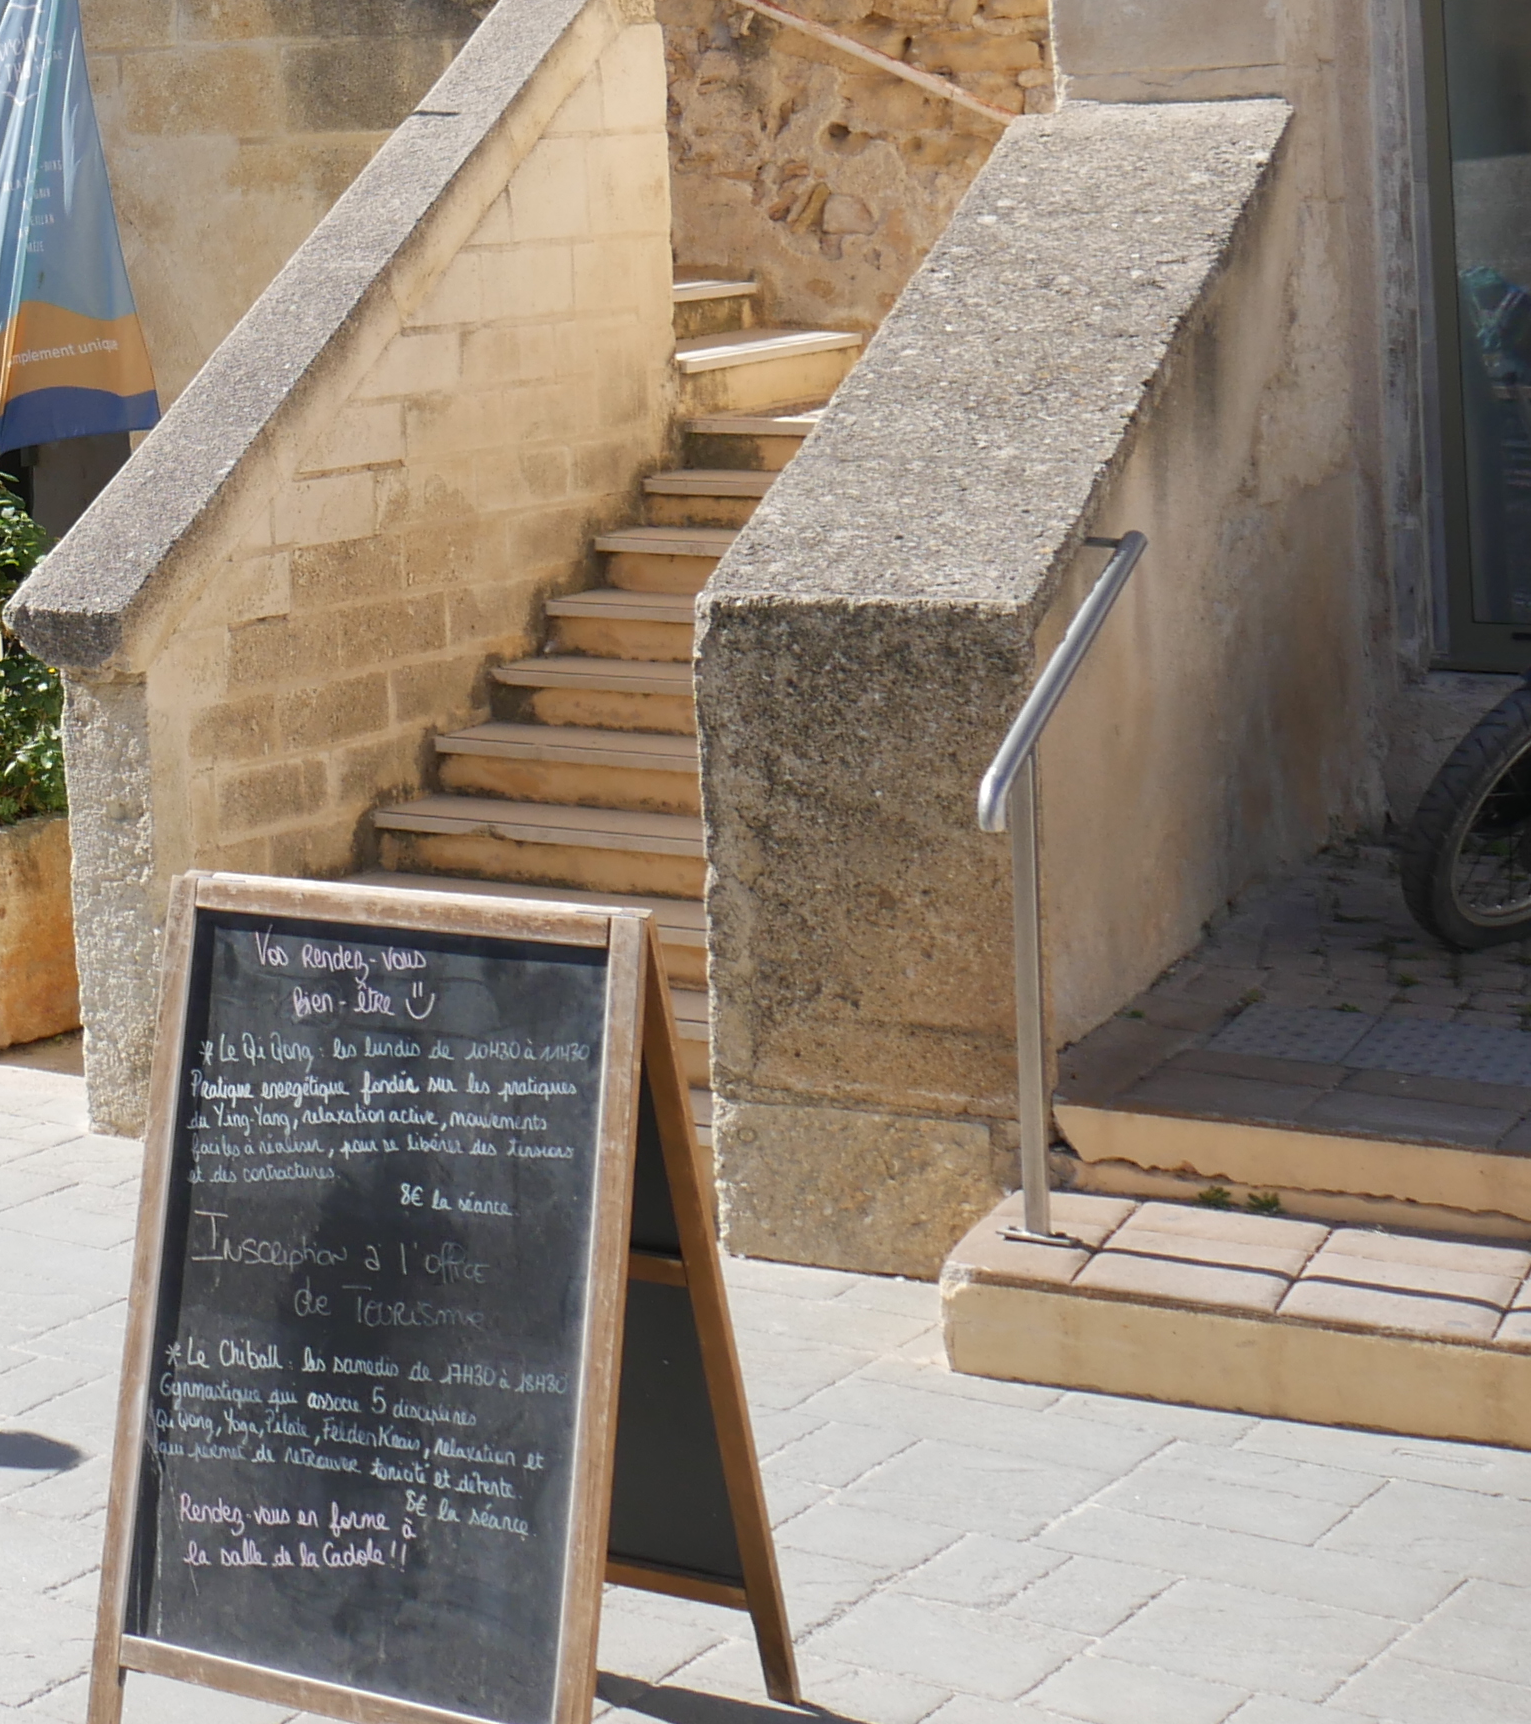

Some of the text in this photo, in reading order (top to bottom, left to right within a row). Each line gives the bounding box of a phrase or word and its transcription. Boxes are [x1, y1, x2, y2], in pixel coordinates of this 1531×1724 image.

[255, 924, 289, 967] Vos
[220, 1033, 239, 1062] Le
[242, 1032, 266, 1066] Qi
[333, 1037, 357, 1059] les
[365, 1036, 421, 1059] lundis
[428, 1039, 455, 1061] de
[464, 1040, 520, 1061] 10H30
[523, 1038, 538, 1061] à
[539, 1041, 590, 1063] 11H30
[191, 1069, 255, 1108] Pratique
[427, 1076, 458, 1094] sur
[465, 1072, 491, 1095] les
[498, 1076, 578, 1103] pratiques
[187, 1110, 211, 1129] du
[302, 1103, 385, 1125] relaxation
[389, 1105, 447, 1132] active,
[450, 1111, 548, 1132] mouvements
[191, 1132, 241, 1163] faciles
[244, 1138, 255, 1155] à
[340, 1138, 378, 1160] pour
[382, 1138, 399, 1153] se
[407, 1132, 464, 1155] libérer
[468, 1138, 498, 1157] des
[506, 1138, 575, 1160] tensions
[188, 1165, 205, 1184] et
[209, 1164, 237, 1184] des
[400, 1182, 424, 1207] 8€
[431, 1188, 452, 1211] la
[363, 1243, 382, 1271] à
[294, 1276, 332, 1317] de
[187, 1337, 211, 1369] Le
[219, 1338, 283, 1370] Chiball
[301, 1346, 327, 1373] les
[333, 1356, 400, 1378] samedis
[408, 1360, 433, 1382] de
[439, 1362, 496, 1387] 17H30
[499, 1368, 512, 1389] à
[514, 1371, 568, 1395] 18H30
[267, 1384, 298, 1413] qui
[306, 1392, 362, 1414] associe
[371, 1385, 387, 1415] 5
[392, 1398, 478, 1427] disciplines
[155, 1407, 174, 1433] Qi
[223, 1407, 264, 1445] Yoga,
[434, 1437, 516, 1466] relaxation
[522, 1454, 544, 1471] et
[158, 1441, 186, 1457] qui
[188, 1441, 247, 1464] permet
[251, 1443, 276, 1464] de
[284, 1446, 362, 1474] retrouver
[370, 1457, 431, 1485] tonicité
[433, 1468, 451, 1489] et
[179, 1492, 417, 1540] Rendez-vous en forme à
[405, 1488, 428, 1518] 8€
[437, 1498, 461, 1523] la
[183, 1539, 211, 1567] la
[220, 1538, 267, 1567] salle
[271, 1544, 293, 1568] de
[299, 1542, 320, 1568] la
